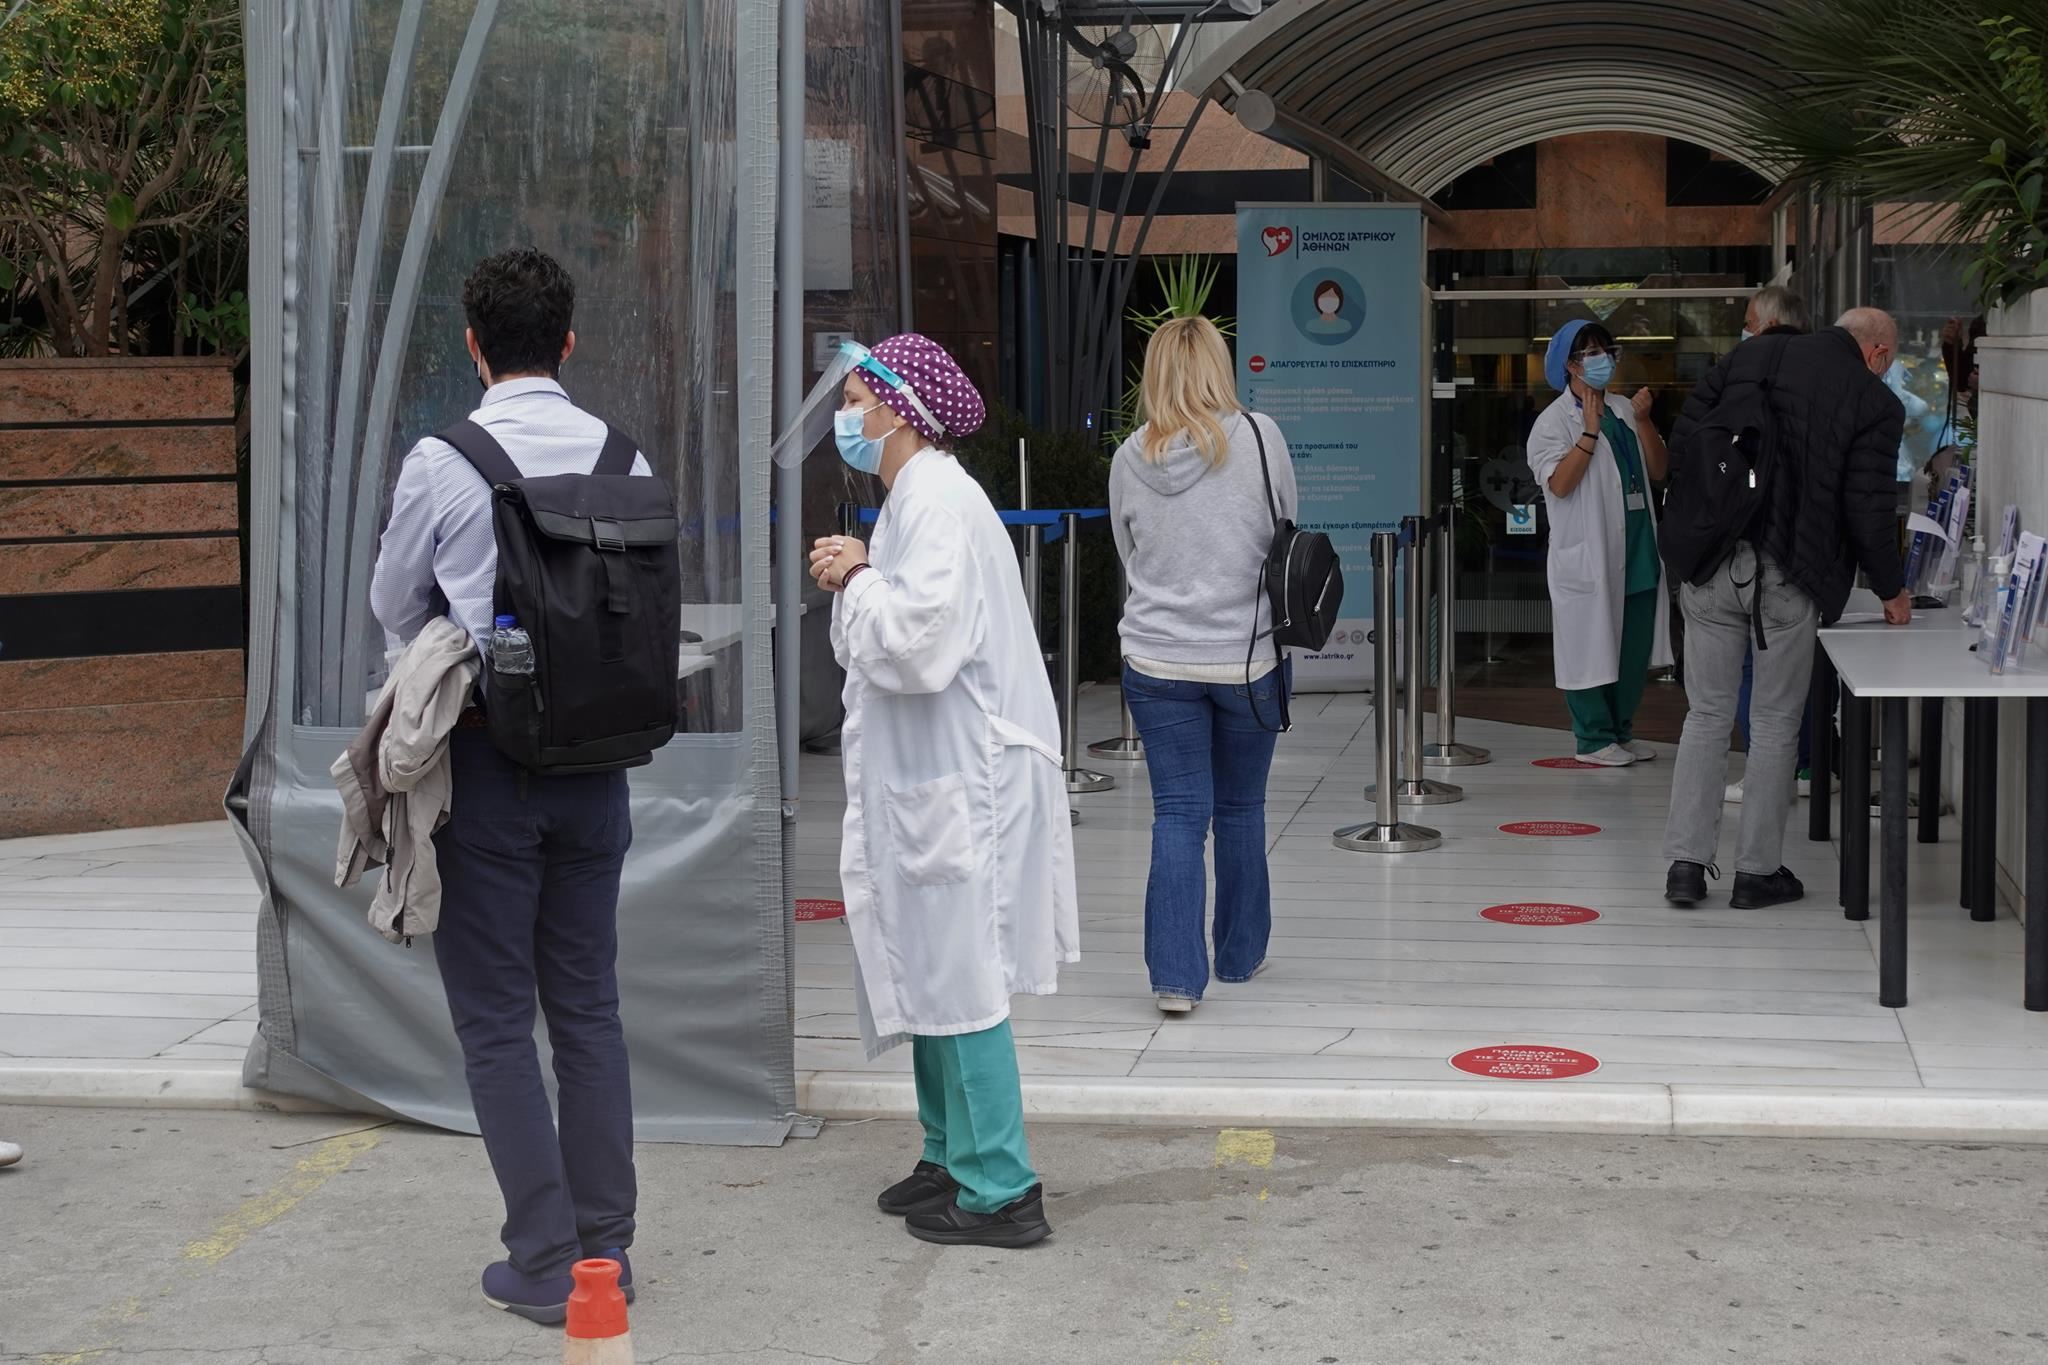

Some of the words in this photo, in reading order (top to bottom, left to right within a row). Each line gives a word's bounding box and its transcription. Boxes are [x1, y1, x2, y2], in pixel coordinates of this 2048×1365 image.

[1302, 231, 1345, 242] ΟΜΙΛΟΣ
[1347, 231, 1396, 242] ΙΑΤΡΙΚΟΥ
[1302, 242, 1350, 252] ΑΘΗΝΩΝ
[1270, 360, 1328, 368] ΑΠΑΓΟΡΕΥΕΤΑΙ
[1329, 360, 1340, 368] ΤΟ
[1341, 360, 1396, 368] ΕΠΙΣΚΕΠΤΗΡΙΟ
[1304, 441, 1344, 451] προσωπικό
[1322, 521, 1350, 531] έγκαιρη
[1304, 653, 1354, 661] www.iatriko.gr
